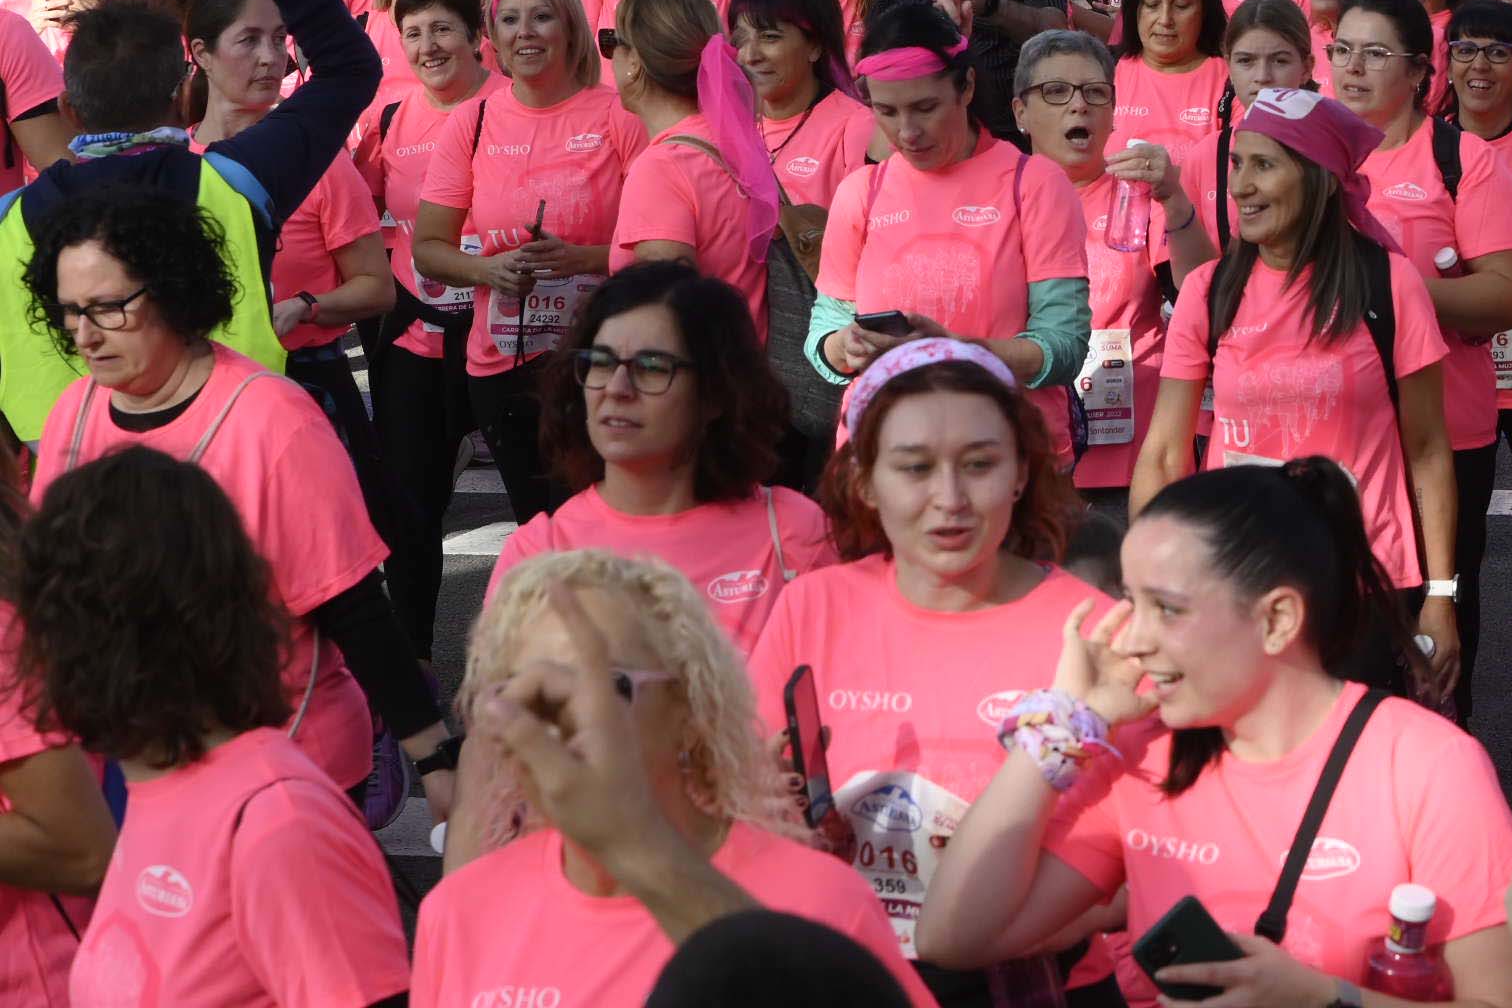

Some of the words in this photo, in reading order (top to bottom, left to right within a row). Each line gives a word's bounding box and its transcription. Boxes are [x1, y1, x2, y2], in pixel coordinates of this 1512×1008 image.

[396, 141, 436, 158] OYSHO
[487, 144, 530, 156] OYSHO
[488, 228, 520, 248] TU
[528, 295, 566, 311] 016
[530, 314, 561, 324] 24292
[1218, 416, 1250, 447] TU
[829, 689, 913, 714] OYSHO
[1126, 828, 1220, 865] OYSHO
[859, 841, 918, 877] 016
